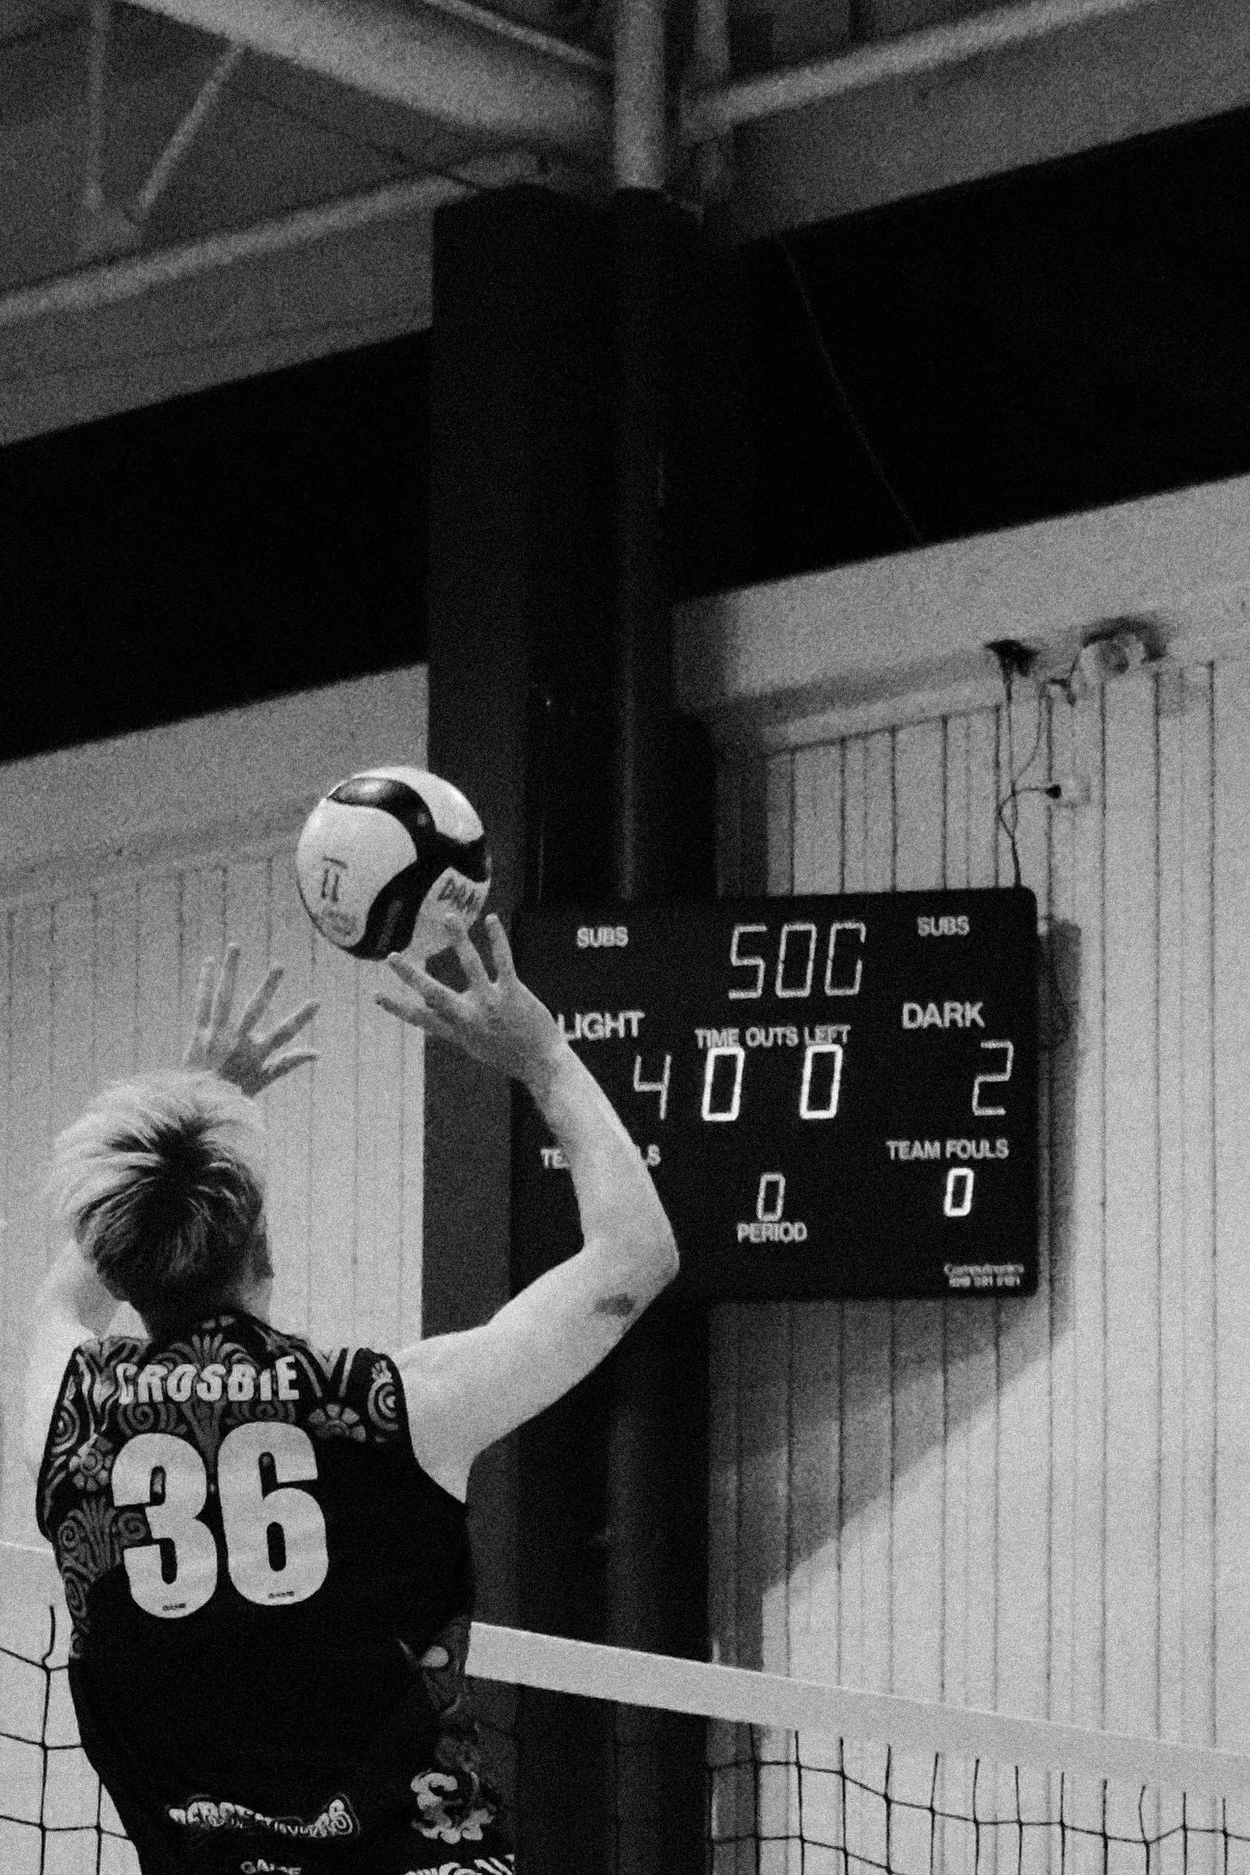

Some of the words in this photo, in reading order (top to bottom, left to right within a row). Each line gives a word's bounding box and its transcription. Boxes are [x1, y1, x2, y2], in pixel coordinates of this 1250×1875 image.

[576, 927, 629, 948] SUBS
[917, 915, 970, 936] SUBS
[558, 1011, 645, 1042] LIGHT
[695, 1028, 739, 1049] TIME
[746, 1026, 799, 1047] OUTS
[803, 1024, 851, 1046] LEFT
[901, 1001, 985, 1029] DARK
[633, 1054, 671, 1120] 4
[701, 1046, 745, 1122] 0
[799, 1044, 843, 1119] 0
[971, 1039, 1014, 1116] 2
[886, 1140, 942, 1160] TEAM
[945, 1137, 1009, 1159] FOULS
[756, 1172, 786, 1222] 0
[944, 1168, 974, 1217] 0
[737, 1222, 808, 1243] PERIOD
[116, 1355, 300, 1405] CROSBIE
[112, 1421, 329, 1619] 36
